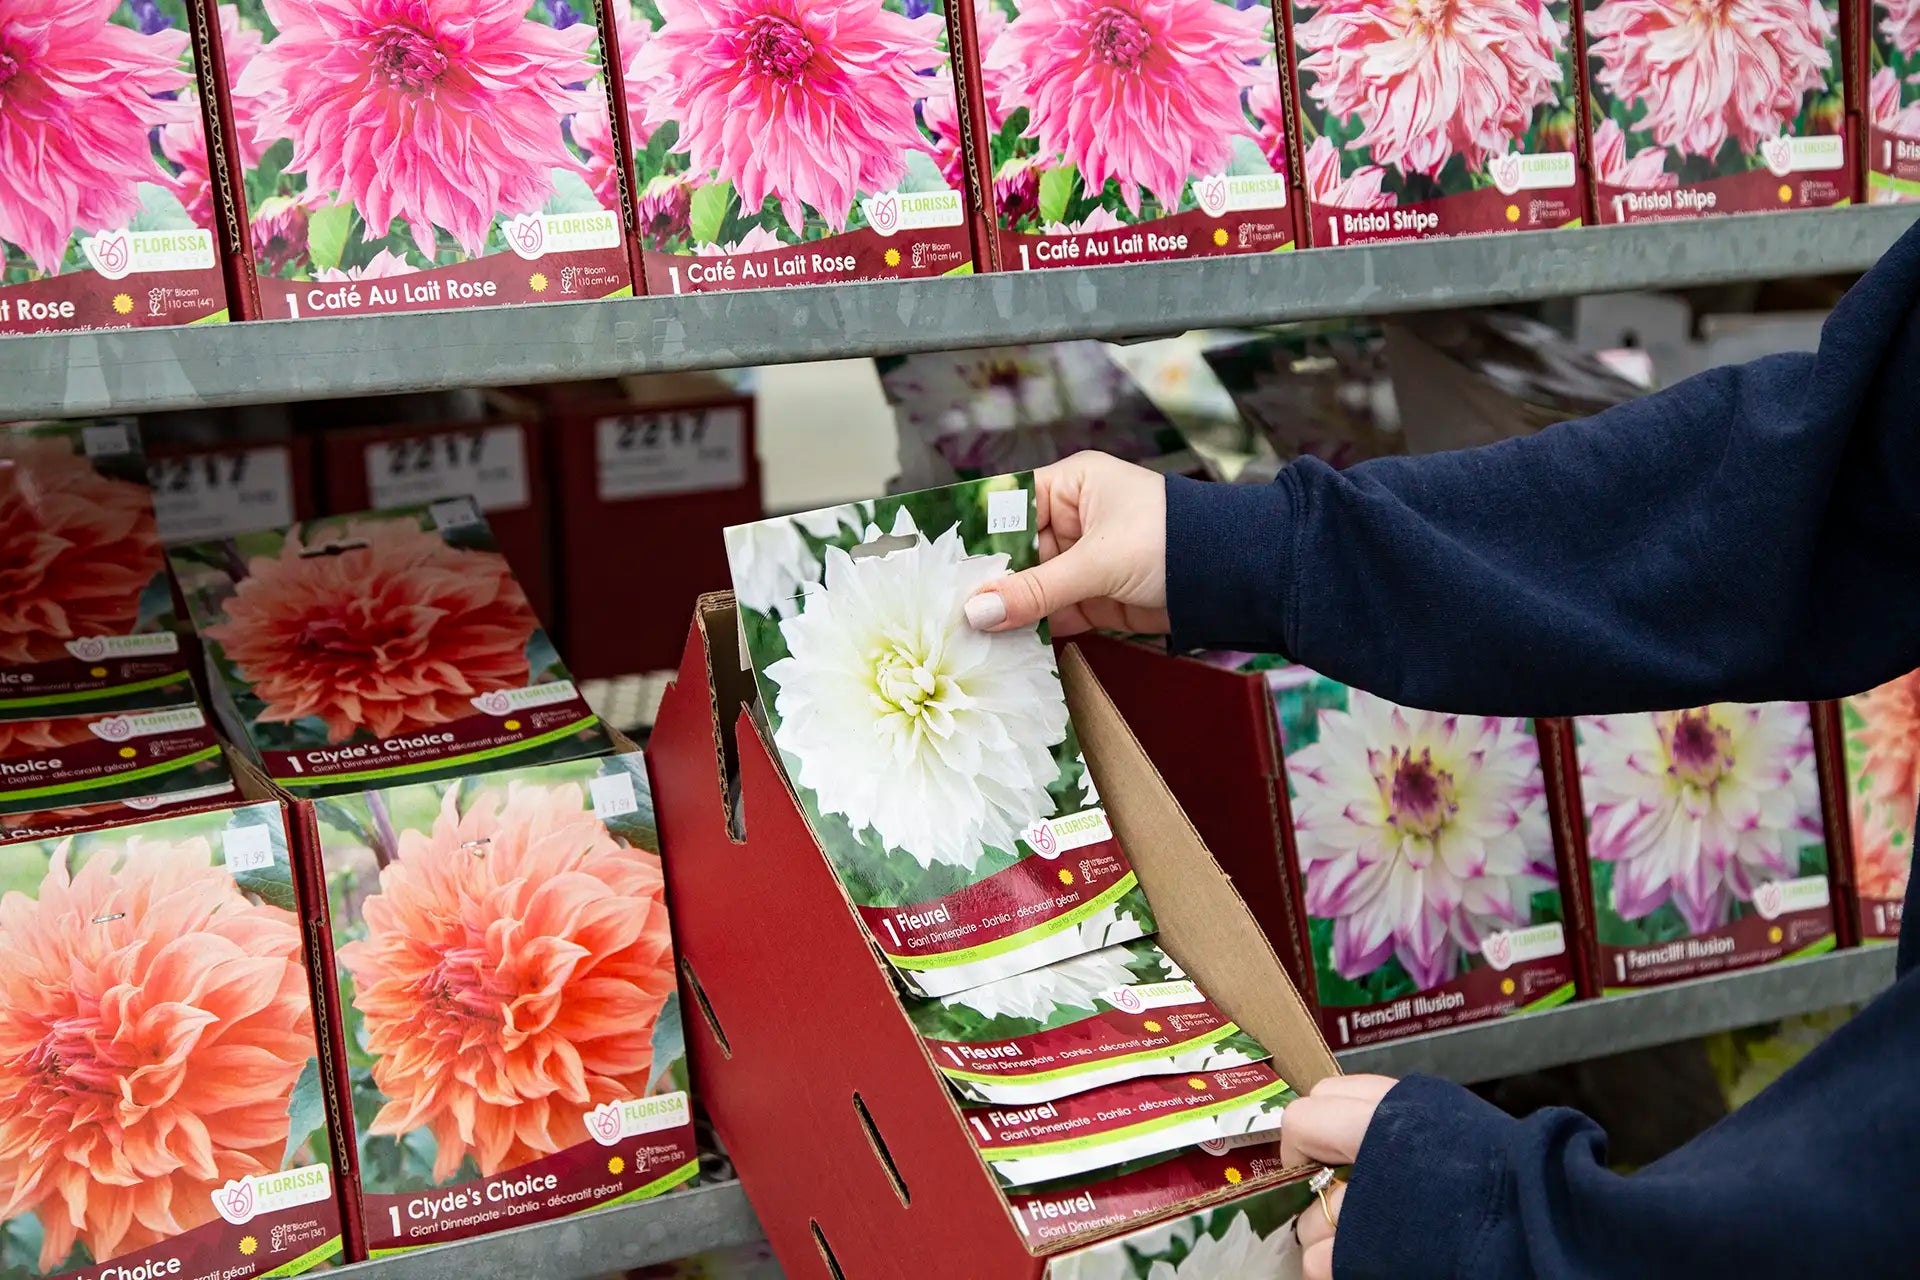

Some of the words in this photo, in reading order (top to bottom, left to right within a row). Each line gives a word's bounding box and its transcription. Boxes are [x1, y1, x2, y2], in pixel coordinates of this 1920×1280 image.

[1883, 139, 1892, 170] 1
[1230, 178, 1280, 195] FLORISSA
[901, 195, 958, 213] FLORISSA
[1613, 194, 1625, 223] 1
[1627, 190, 1672, 212] Bristol
[1674, 188, 1717, 210] Stripe
[547, 216, 614, 235] FLORISSA
[1328, 215, 1339, 246] 1
[1343, 211, 1391, 233] Bristol
[1392, 209, 1439, 233] Stripe
[133, 235, 208, 254] FLORISSA
[932, 243, 951, 251] Bloom
[1019, 244, 1030, 270] 1
[1036, 237, 1080, 260] Café
[1085, 238, 1109, 257] Au
[1113, 234, 1143, 255] Lait
[1147, 233, 1188, 252] Rose
[926, 253, 938, 262] 110
[578, 277, 590, 286] 110
[605, 275, 620, 286] (44")
[584, 266, 606, 275] Bloom
[668, 266, 681, 294] 1
[687, 258, 736, 283] Café
[742, 259, 768, 279] Au
[774, 254, 807, 276] Lait
[812, 254, 856, 273] Rose
[168, 300, 181, 309] 110
[183, 301, 196, 309] cm
[198, 298, 214, 309] (44")
[175, 288, 199, 297] Bloom
[286, 293, 299, 319] 1
[307, 285, 361, 310] Café
[368, 285, 397, 306] Au
[404, 281, 440, 303] Lait
[446, 280, 497, 299] Rose
[17, 299, 75, 321] Rose
[617, 412, 711, 450] 2217
[0, 672, 34, 685] ice
[511, 684, 569, 701] FLORISSA
[133, 712, 198, 726] FLORISSA
[287, 756, 304, 773] 1
[306, 744, 380, 765] Clyde's
[384, 732, 455, 752] Choice
[0, 758, 62, 775] hoice
[1053, 813, 1104, 837] FLORISSA
[883, 918, 902, 947] 1
[896, 904, 951, 932] Fleurel
[908, 935, 931, 949] Giant
[931, 923, 977, 944] Dinnerplate
[982, 916, 1011, 929] Dahlia
[1017, 900, 1056, 918] décoratif
[1056, 891, 1080, 909] géant
[1873, 905, 1886, 934] 1
[1614, 953, 1627, 983] 1
[1627, 942, 1684, 969] Ferncliff
[1687, 936, 1735, 958] Illusion
[1137, 983, 1193, 998] FLORISSA
[1337, 1015, 1350, 1045] 1
[1352, 1000, 1412, 1030] Ferncliff
[1413, 991, 1465, 1016] Illusion
[941, 1046, 963, 1067] 1
[962, 1042, 1023, 1061] Fleurel
[972, 1061, 998, 1071] Giant
[1000, 1055, 1054, 1071] Dinnerplate
[1060, 1047, 1092, 1059] Dahlia
[1099, 1040, 1140, 1053] décoratif
[1142, 1036, 1170, 1047] géant
[625, 1098, 684, 1121] FLORISSA
[1000, 1129, 1030, 1142] Giant
[1032, 1117, 1091, 1136] Dinnerplate
[1097, 1106, 1132, 1122] Dahlia
[1139, 1098, 1184, 1113] décoratif
[1185, 1093, 1215, 1106] géant
[969, 1116, 992, 1142] 1
[988, 1102, 1059, 1128] Fleurel
[661, 1155, 670, 1163] cm
[257, 1170, 324, 1197] FLORISSA
[388, 1206, 402, 1238] 1
[408, 1187, 482, 1220] Clyde's
[486, 1174, 557, 1202] Choice
[410, 1222, 439, 1238] Giant
[441, 1210, 500, 1231] Dinnerplate
[507, 1202, 540, 1216] Dahlia
[547, 1189, 592, 1208] décoratif
[593, 1181, 623, 1199] géant
[1011, 1206, 1030, 1237] 1
[1027, 1191, 1096, 1221] Fleurel
[288, 1234, 297, 1243] 90
[297, 1233, 310, 1241] cm
[311, 1226, 326, 1239] (36")
[1038, 1222, 1066, 1239] Giant
[100, 1257, 181, 1280] Choice
[223, 1261, 256, 1279] géant
